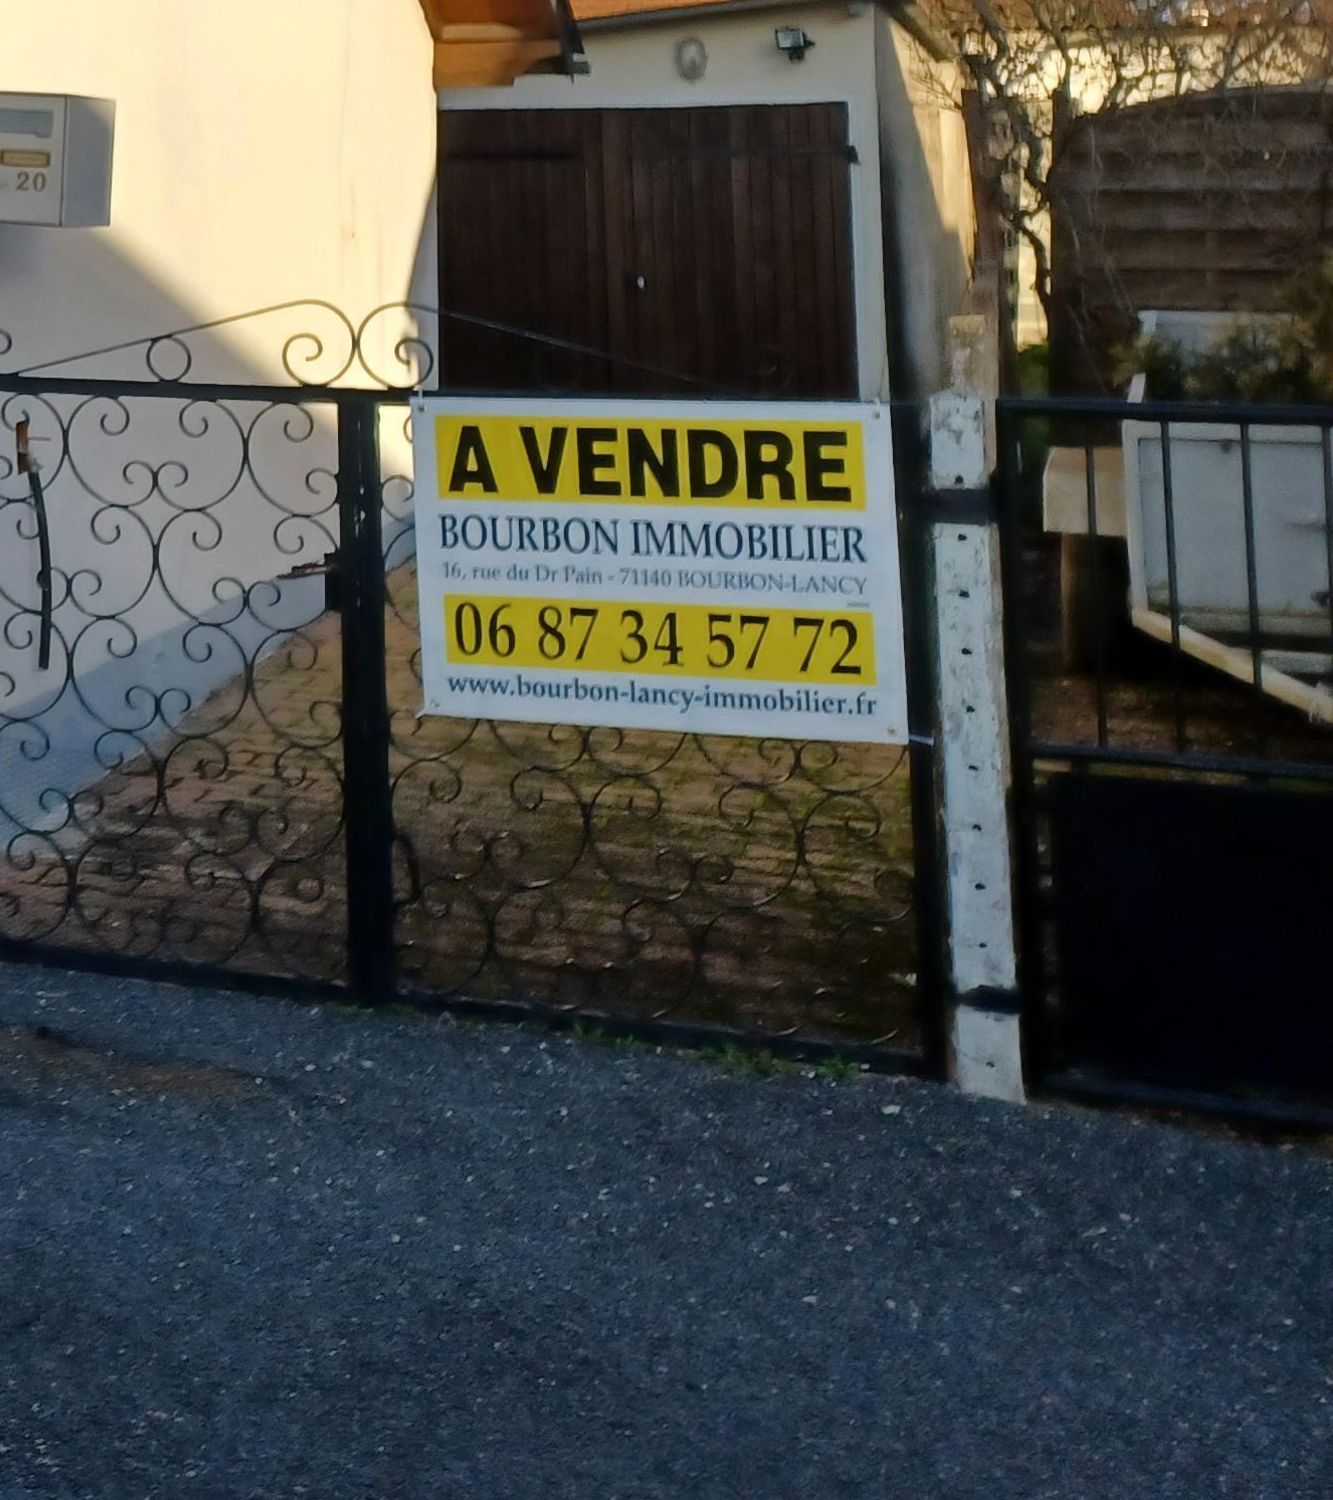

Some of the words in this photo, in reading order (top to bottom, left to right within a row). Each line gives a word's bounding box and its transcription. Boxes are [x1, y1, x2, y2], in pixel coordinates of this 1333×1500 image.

[16, 172, 46, 192] 20
[448, 425, 499, 494] A
[519, 426, 852, 502] VENDRE
[438, 513, 621, 556] BOURBON
[630, 519, 869, 564] IMMOBILIER
[442, 560, 467, 581] 16,
[472, 565, 502, 578] rue
[506, 563, 530, 582] du
[535, 564, 559, 583] Dr
[563, 565, 603, 585] Pain
[620, 568, 671, 588] 71140
[677, 569, 869, 595] BOURBON-LANCY
[454, 601, 516, 658] 06
[537, 605, 600, 662] 87
[619, 609, 684, 668] 34
[707, 613, 770, 671] 57
[793, 617, 862, 675] 72
[447, 674, 878, 716] www.bourbon-lancy-immobilier.fr
